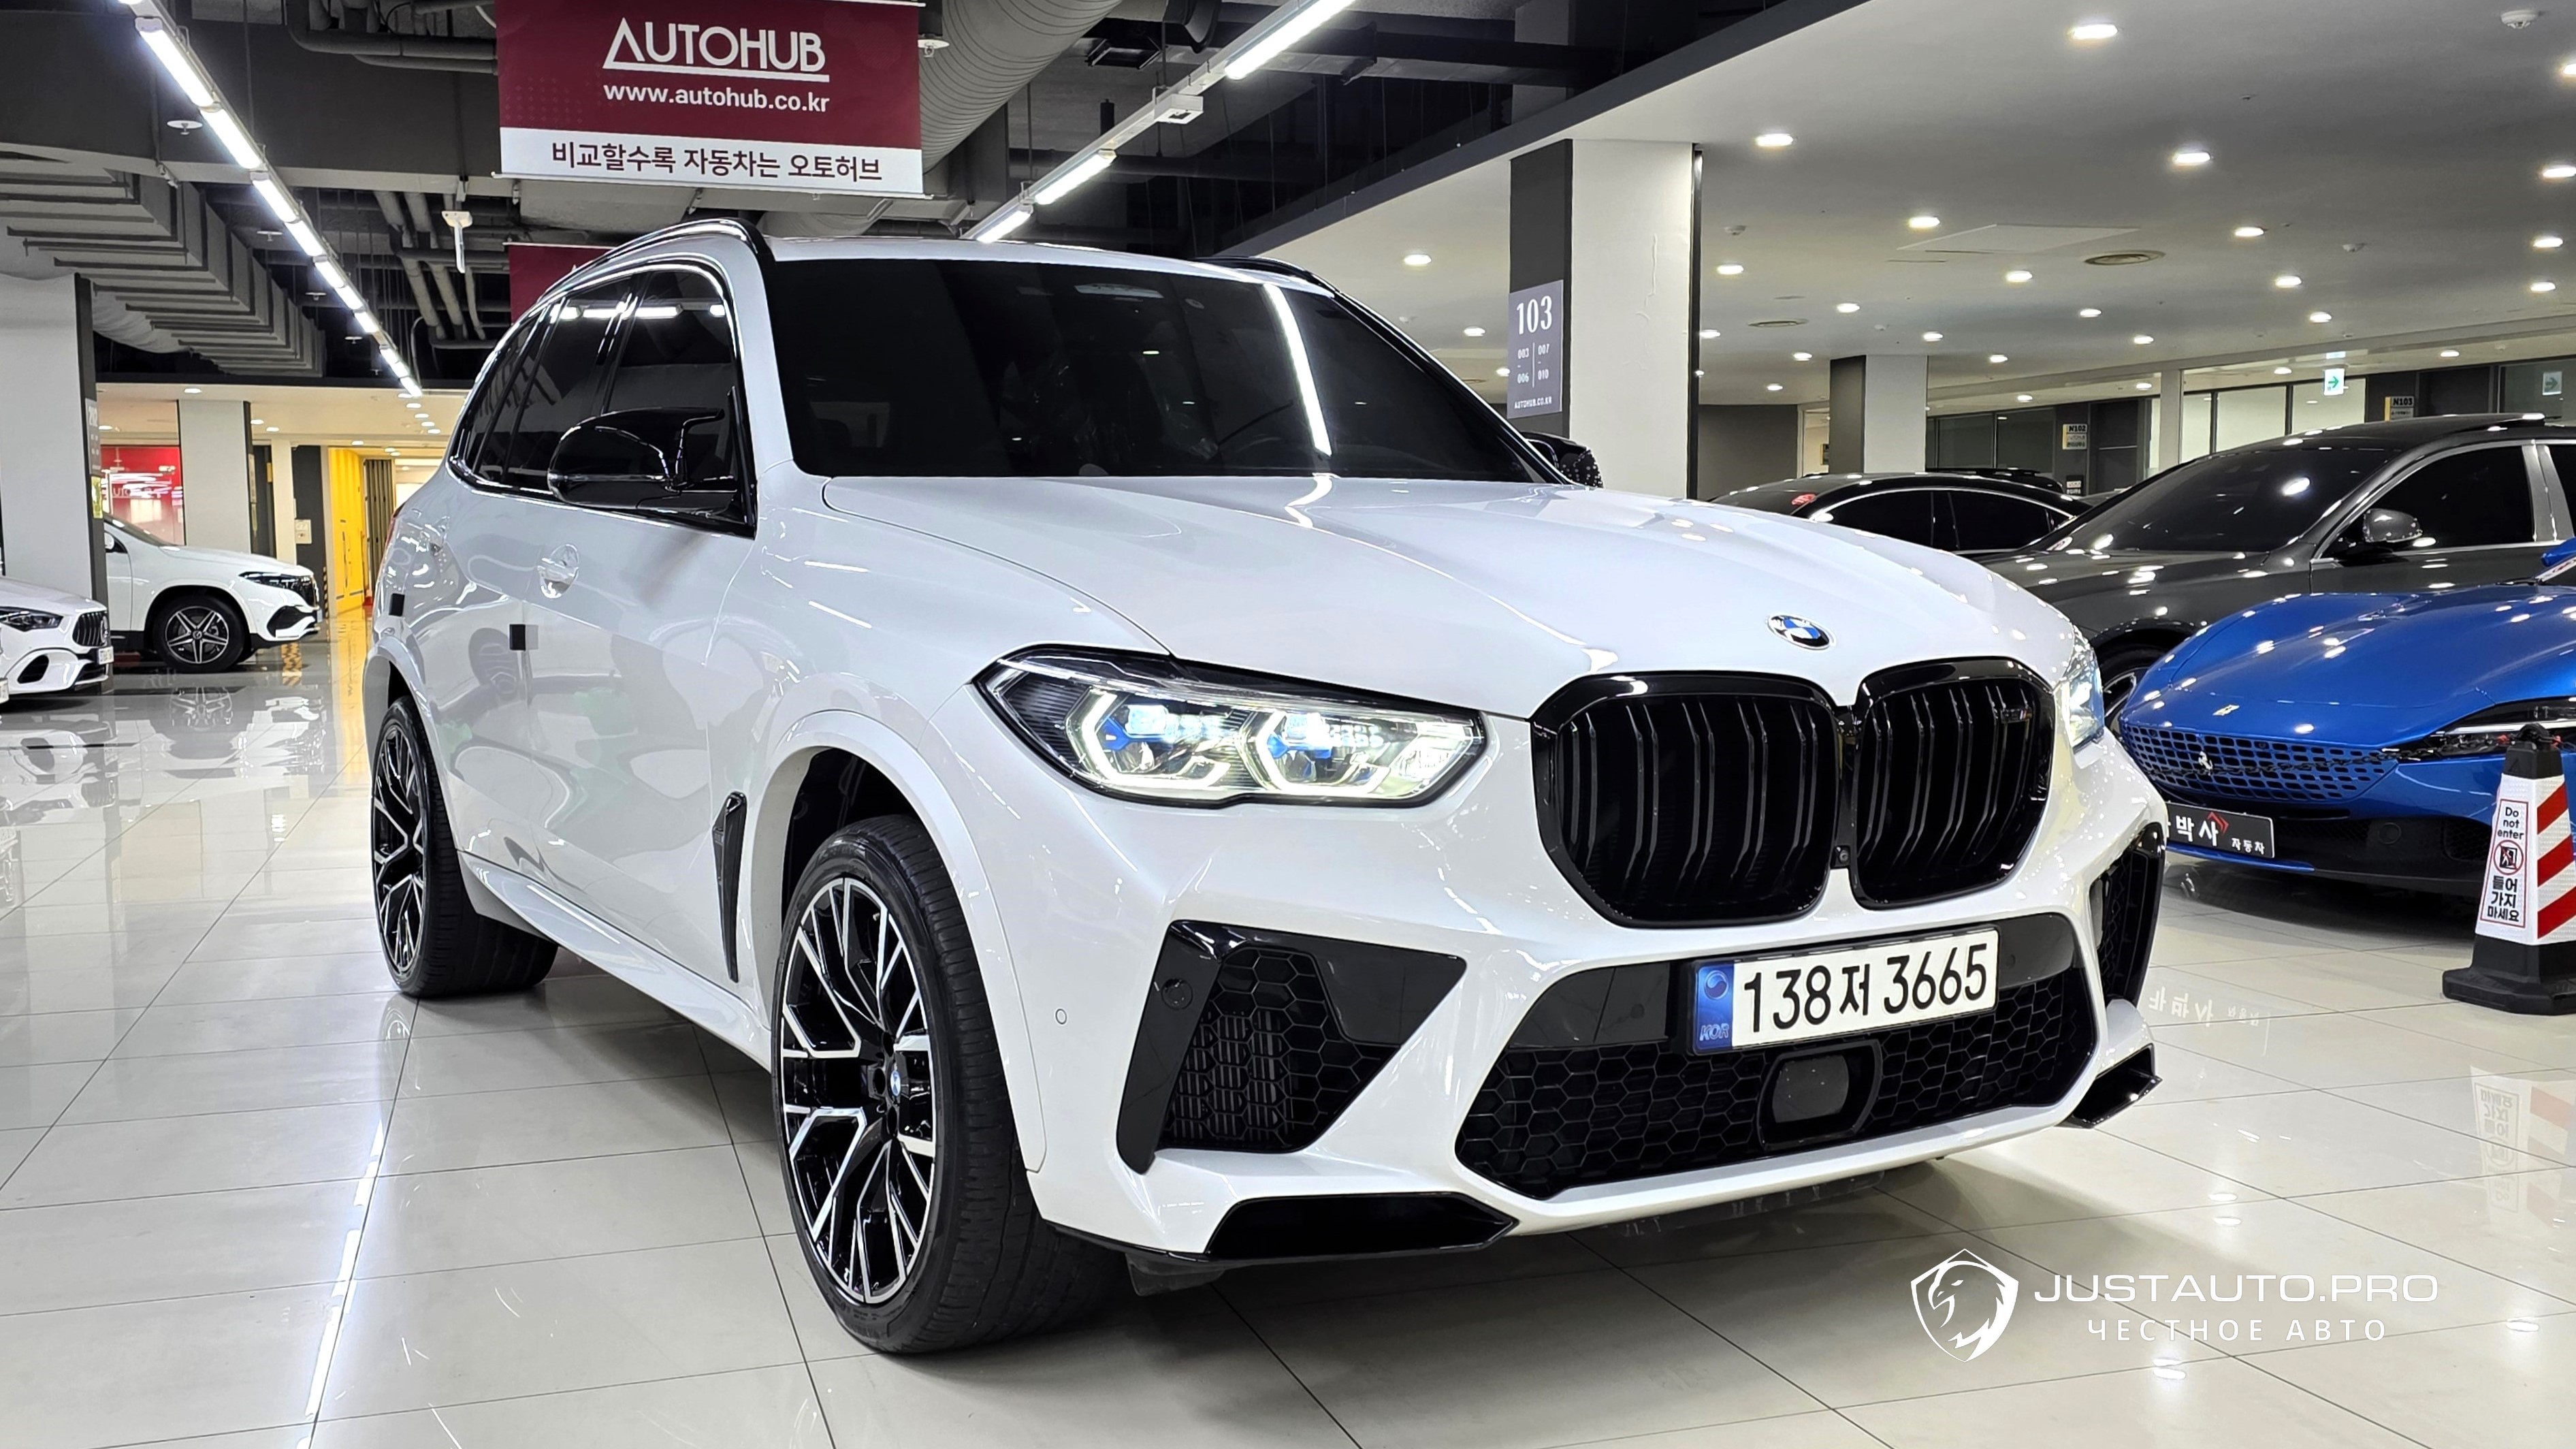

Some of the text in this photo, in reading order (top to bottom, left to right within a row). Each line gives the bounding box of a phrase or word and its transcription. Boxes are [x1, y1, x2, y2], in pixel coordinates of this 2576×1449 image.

[602, 17, 827, 74] AUTOHUB
[603, 84, 830, 112] www.autohub.co.kr
[551, 142, 882, 182] 비교할수록 자동차는 오토허브
[1516, 295, 1553, 335] 103
[1517, 348, 1530, 359] 003
[1538, 343, 1550, 355] 007
[1517, 373, 1530, 384] 006
[1537, 368, 1549, 380] 010
[1514, 396, 1552, 409] AUTOHUB.CO.KR
[2393, 398, 2413, 406] N103
[2505, 806, 2519, 818] Do
[2167, 814, 2219, 847] 박사
[2502, 819, 2520, 829] not
[2497, 829, 2524, 840] enter
[2492, 875, 2518, 893] 들어
[2490, 891, 2517, 908] 가지
[2487, 905, 2519, 923] 마세요
[1743, 943, 1988, 1034] 138저 3665
[1699, 1023, 1730, 1041] KOR
